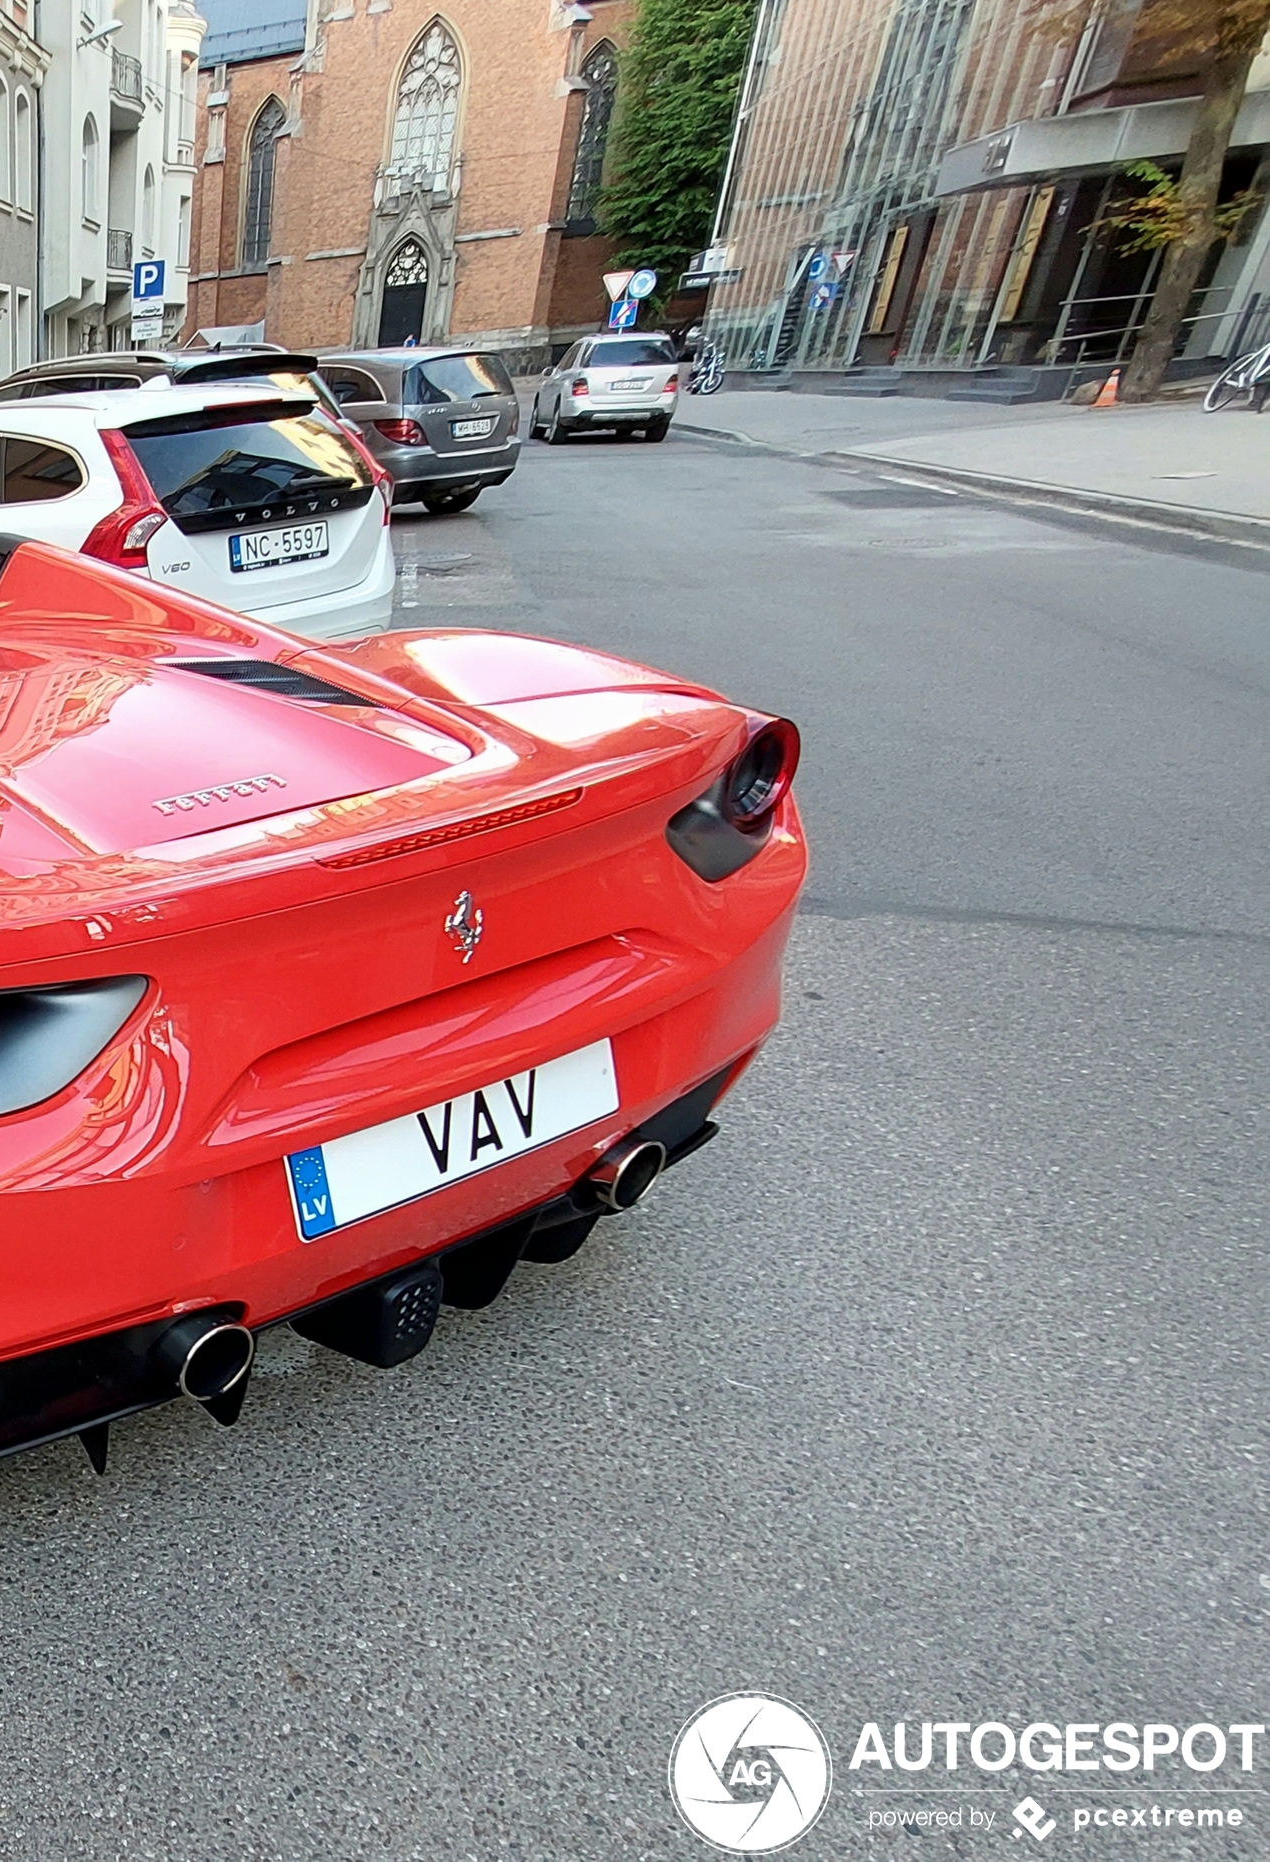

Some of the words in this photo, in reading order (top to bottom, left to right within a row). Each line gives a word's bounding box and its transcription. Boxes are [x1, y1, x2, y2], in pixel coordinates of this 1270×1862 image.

[139, 264, 159, 296] P
[234, 498, 340, 522] VOLVO
[245, 526, 324, 561] NC-5597
[161, 561, 191, 575] V60
[152, 773, 288, 816] Ferrari
[416, 1068, 536, 1175] VAV
[301, 1194, 328, 1222] LV
